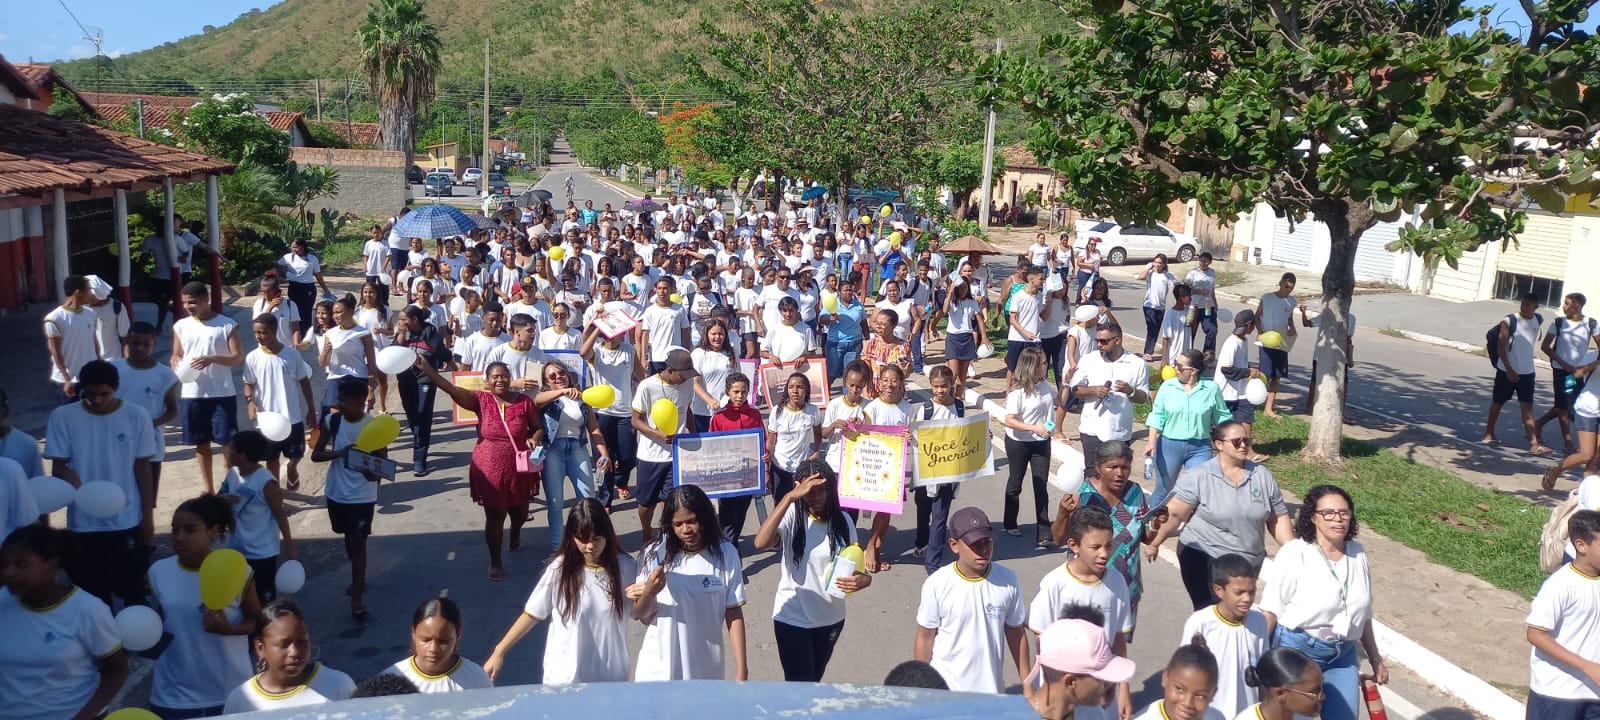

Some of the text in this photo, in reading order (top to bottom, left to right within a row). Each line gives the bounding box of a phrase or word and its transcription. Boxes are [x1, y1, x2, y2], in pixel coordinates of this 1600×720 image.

[923, 437, 970, 456] Você é
[928, 441, 980, 467] Incrível
